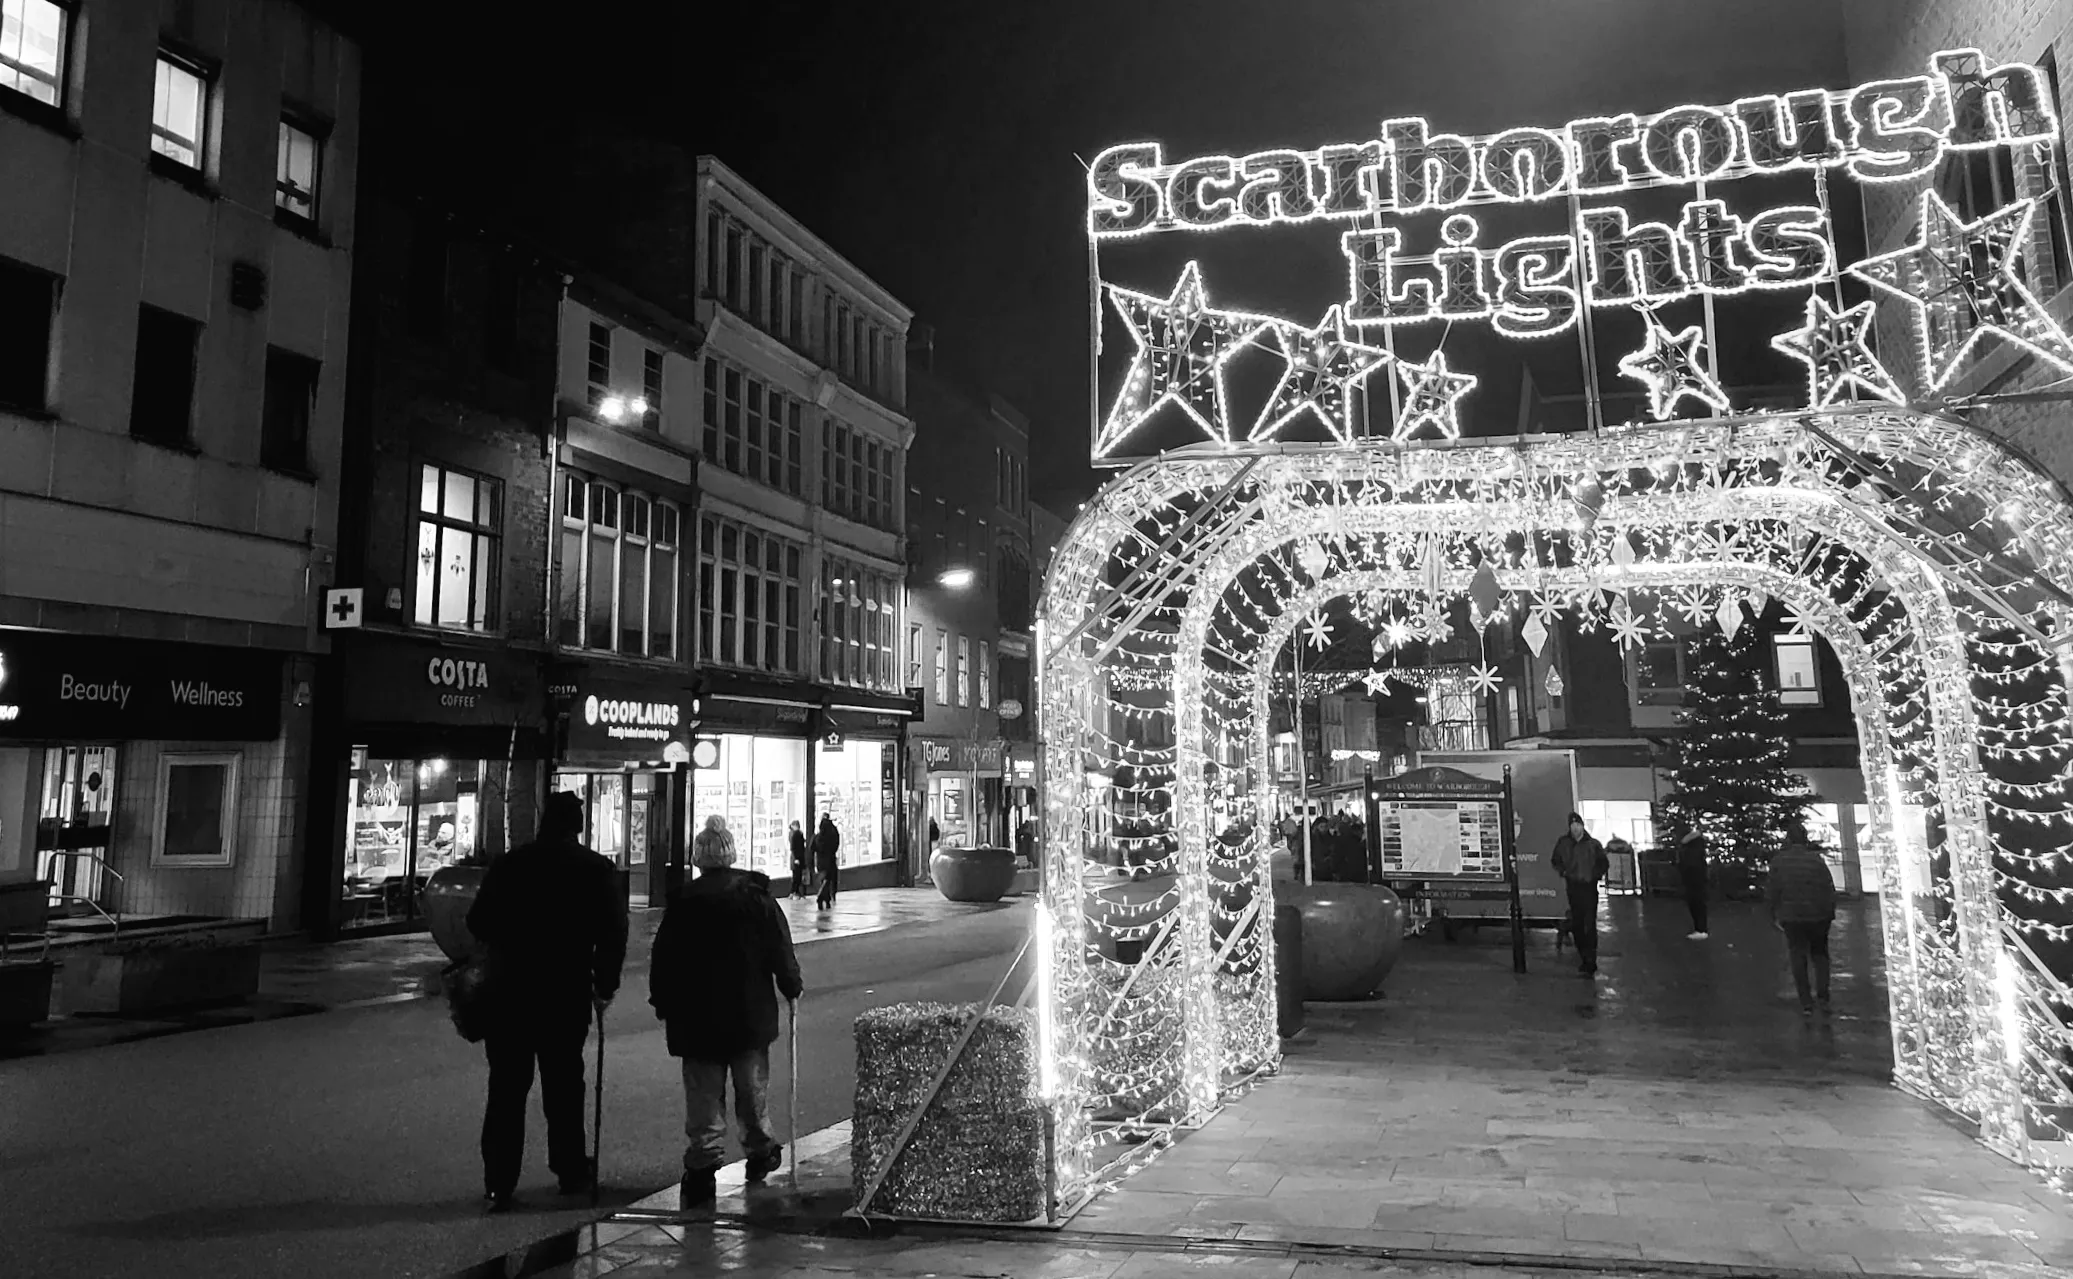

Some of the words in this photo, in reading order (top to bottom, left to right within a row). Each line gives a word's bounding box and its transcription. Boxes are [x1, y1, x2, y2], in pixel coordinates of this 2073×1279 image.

[1087, 46, 2059, 237] Scarborough
[1342, 199, 1832, 338] Lights
[428, 657, 488, 690] COSTA
[60, 673, 131, 710] Beauty
[171, 680, 243, 707] Wellness
[441, 694, 475, 708] COFFEE
[548, 685, 577, 695] COSTA
[600, 700, 679, 726] COOPLANDS
[1415, 890, 1471, 898] INFORMATION
